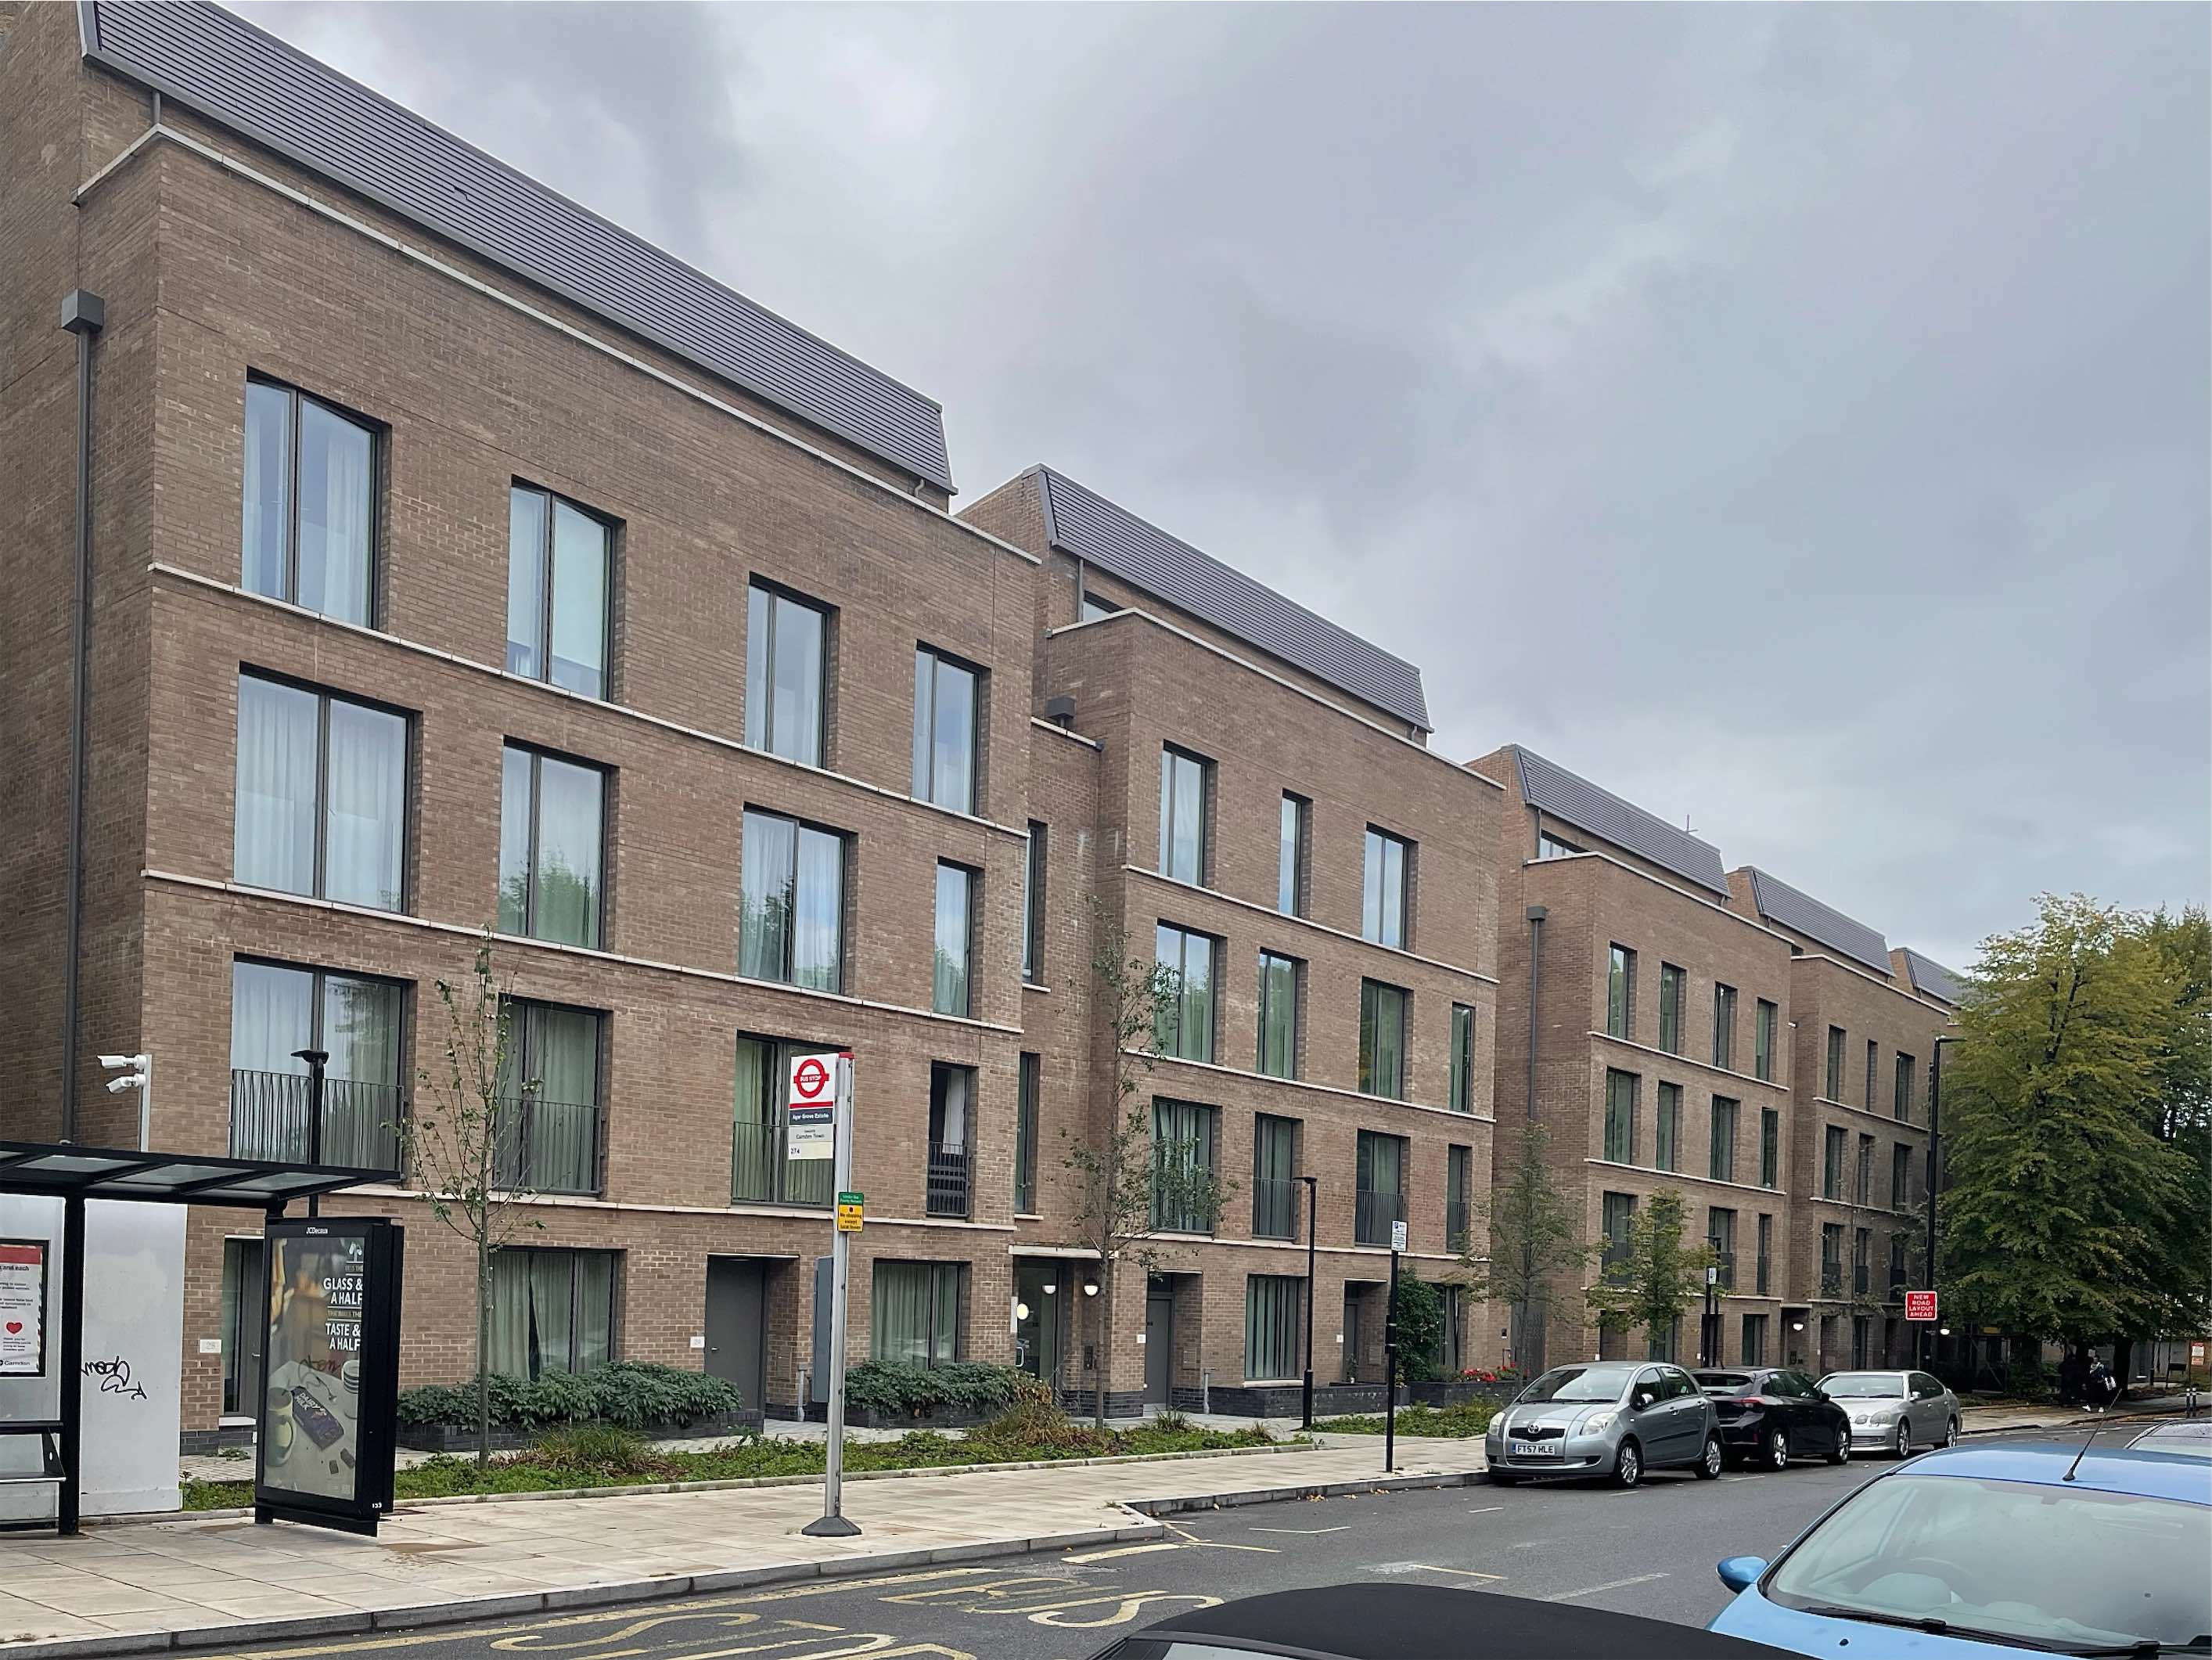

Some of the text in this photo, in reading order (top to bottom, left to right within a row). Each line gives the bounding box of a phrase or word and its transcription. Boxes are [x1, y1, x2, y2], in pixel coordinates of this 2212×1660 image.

[323, 1277, 363, 1291] GLASS &
[330, 1291, 363, 1305] A HALF
[325, 1323, 361, 1338] TASTE &
[329, 1338, 361, 1352] A HALF
[878, 1576, 1227, 1628] BUS
